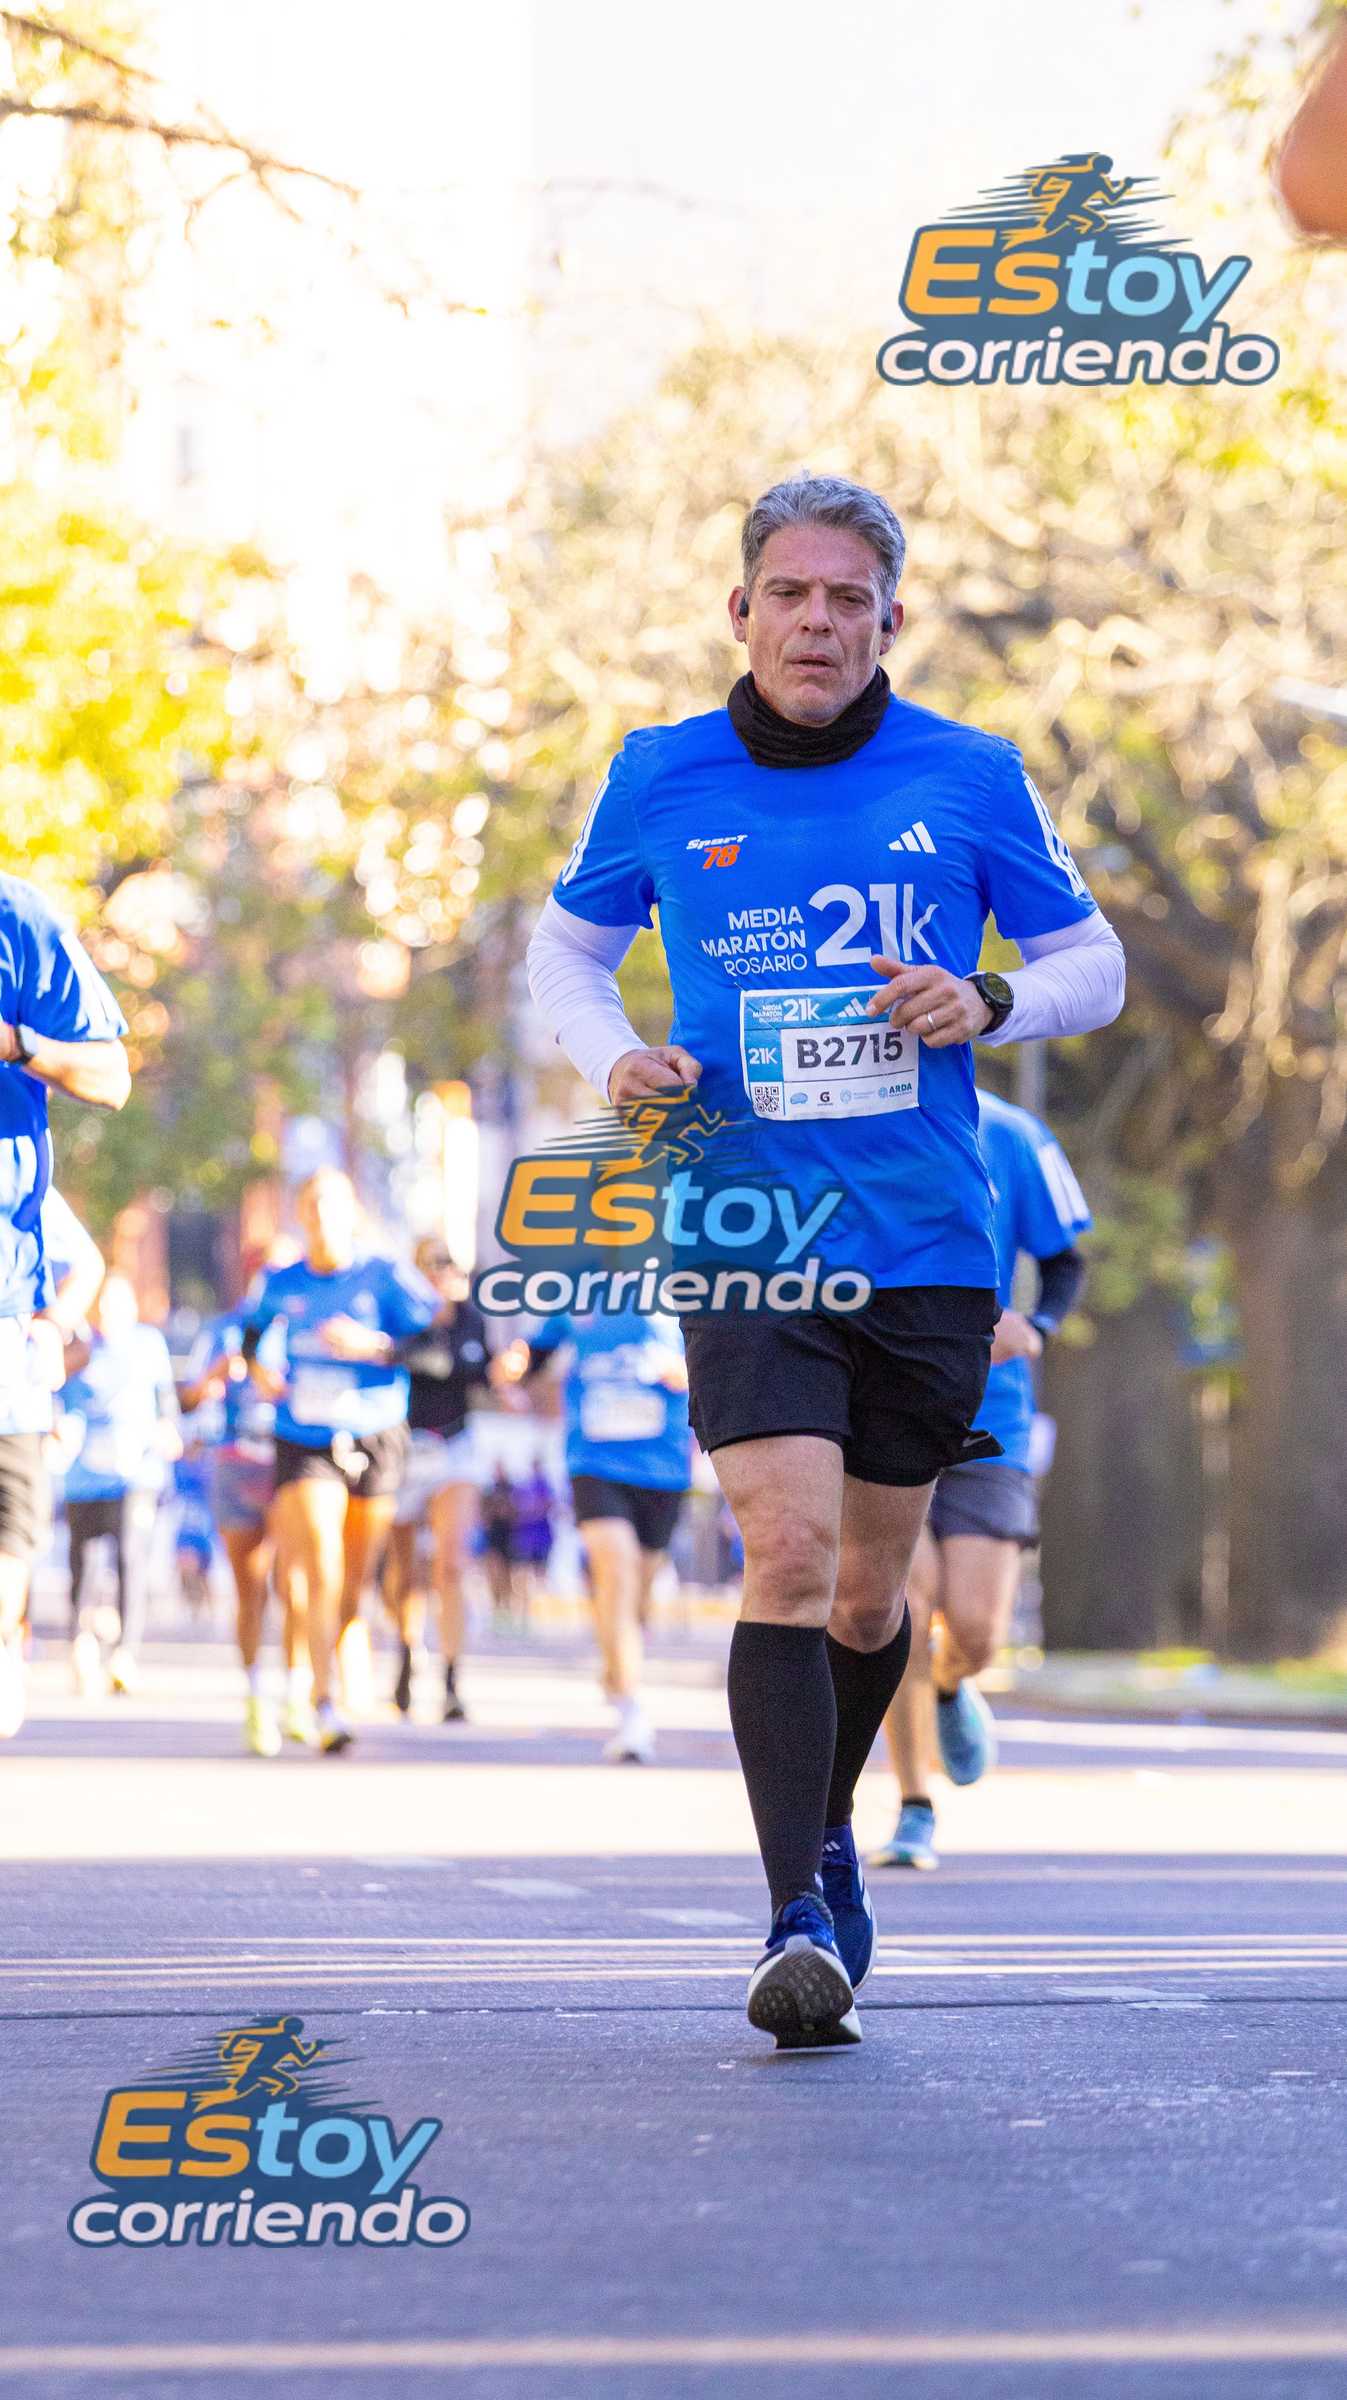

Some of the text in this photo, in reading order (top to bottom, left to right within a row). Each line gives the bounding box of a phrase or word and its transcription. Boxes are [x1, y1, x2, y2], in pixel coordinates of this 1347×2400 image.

[703, 844, 741, 869] 78
[728, 906, 804, 930] MEDIA
[701, 926, 806, 957] MARATÓN
[724, 953, 808, 977] ROSARIO
[748, 1047, 778, 1065] 21K
[797, 1032, 903, 1069] B2715
[889, 1083, 912, 1094] ARDA
